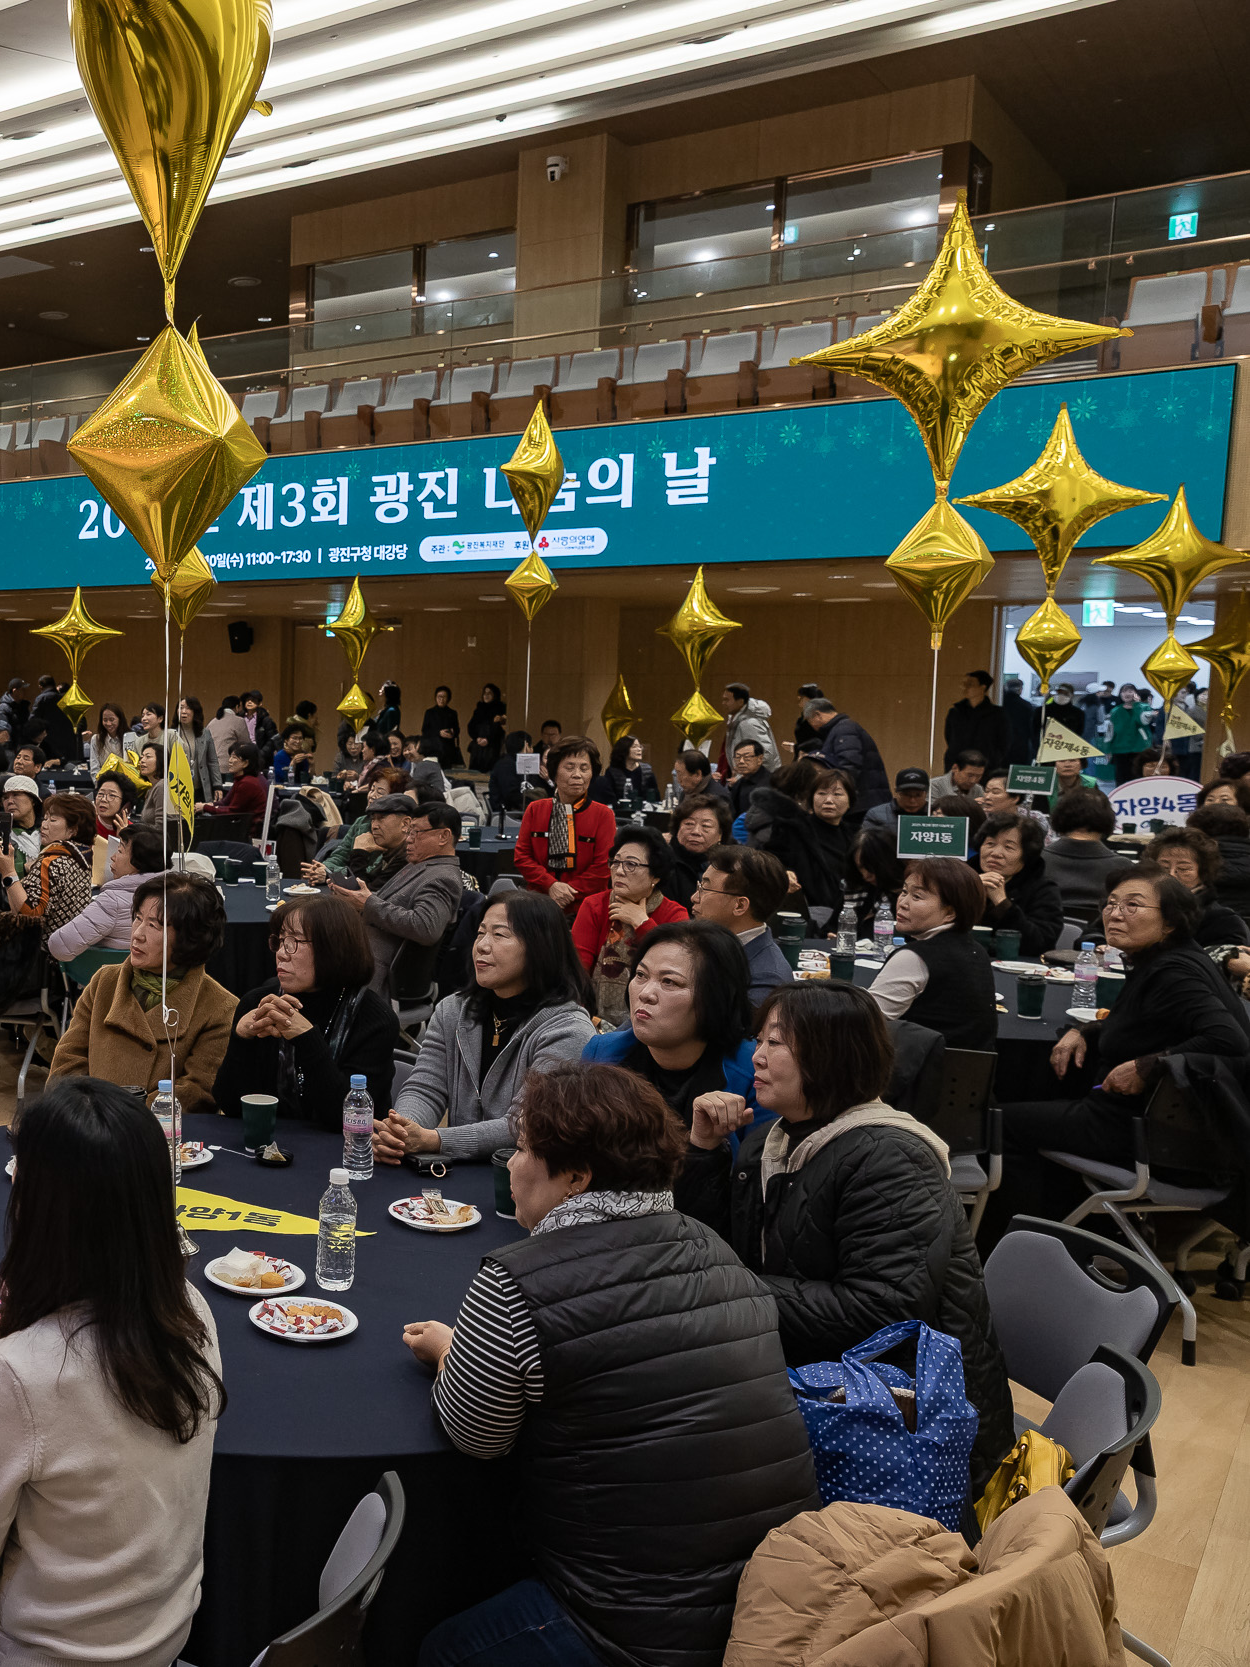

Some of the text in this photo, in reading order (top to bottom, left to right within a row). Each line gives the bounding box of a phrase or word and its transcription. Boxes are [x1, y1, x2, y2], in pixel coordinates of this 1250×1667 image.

[237, 477, 348, 531] 제3회
[369, 467, 458, 524] 광진
[662, 446, 717, 506] 날
[246, 549, 311, 566] 11:00~17:30
[328, 546, 372, 563] 광진구청
[373, 544, 408, 561] 대강당
[514, 541, 530, 550] 후원
[1043, 738, 1090, 756] 자양제4동
[1113, 793, 1197, 817] 자양4동
[910, 831, 953, 843] 자양1동
